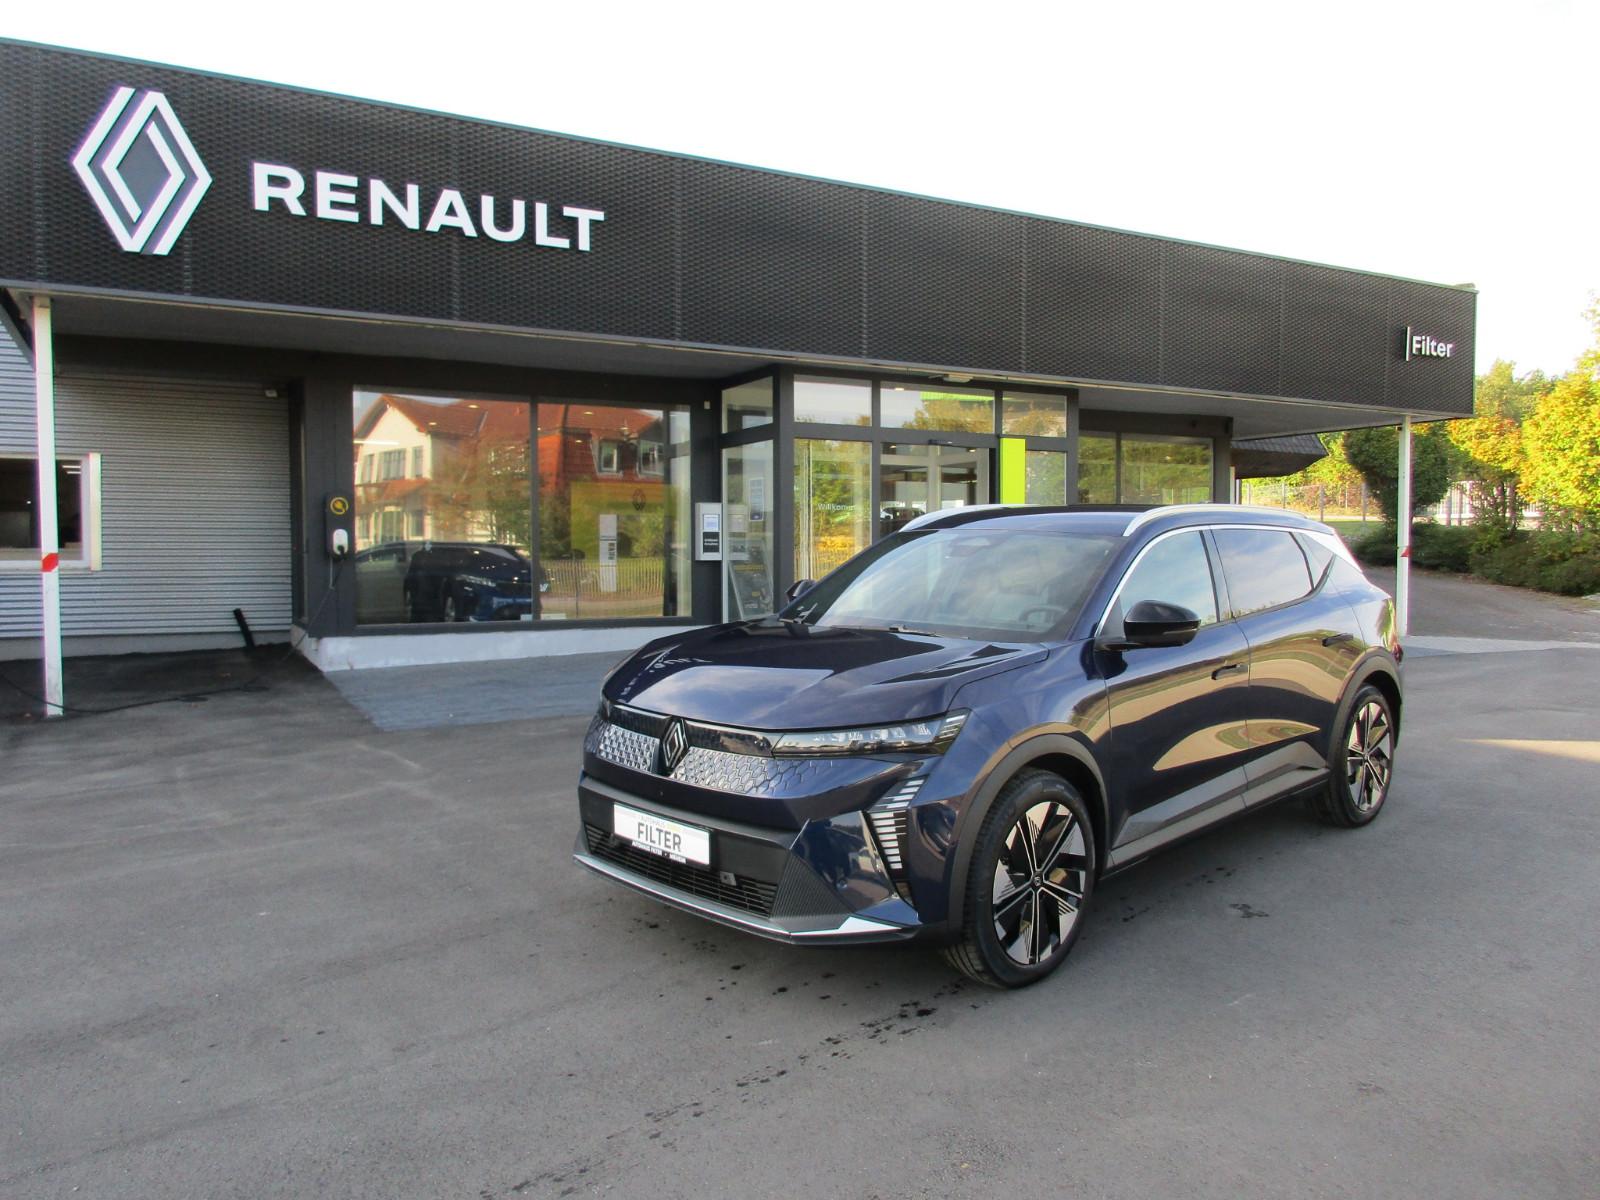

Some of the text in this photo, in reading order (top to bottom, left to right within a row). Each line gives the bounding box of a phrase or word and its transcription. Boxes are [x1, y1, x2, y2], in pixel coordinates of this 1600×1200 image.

[252, 162, 605, 252] RENAULT
[1412, 335, 1453, 358] Filter
[817, 503, 857, 513] Willkomm
[637, 822, 681, 852] FILTER
